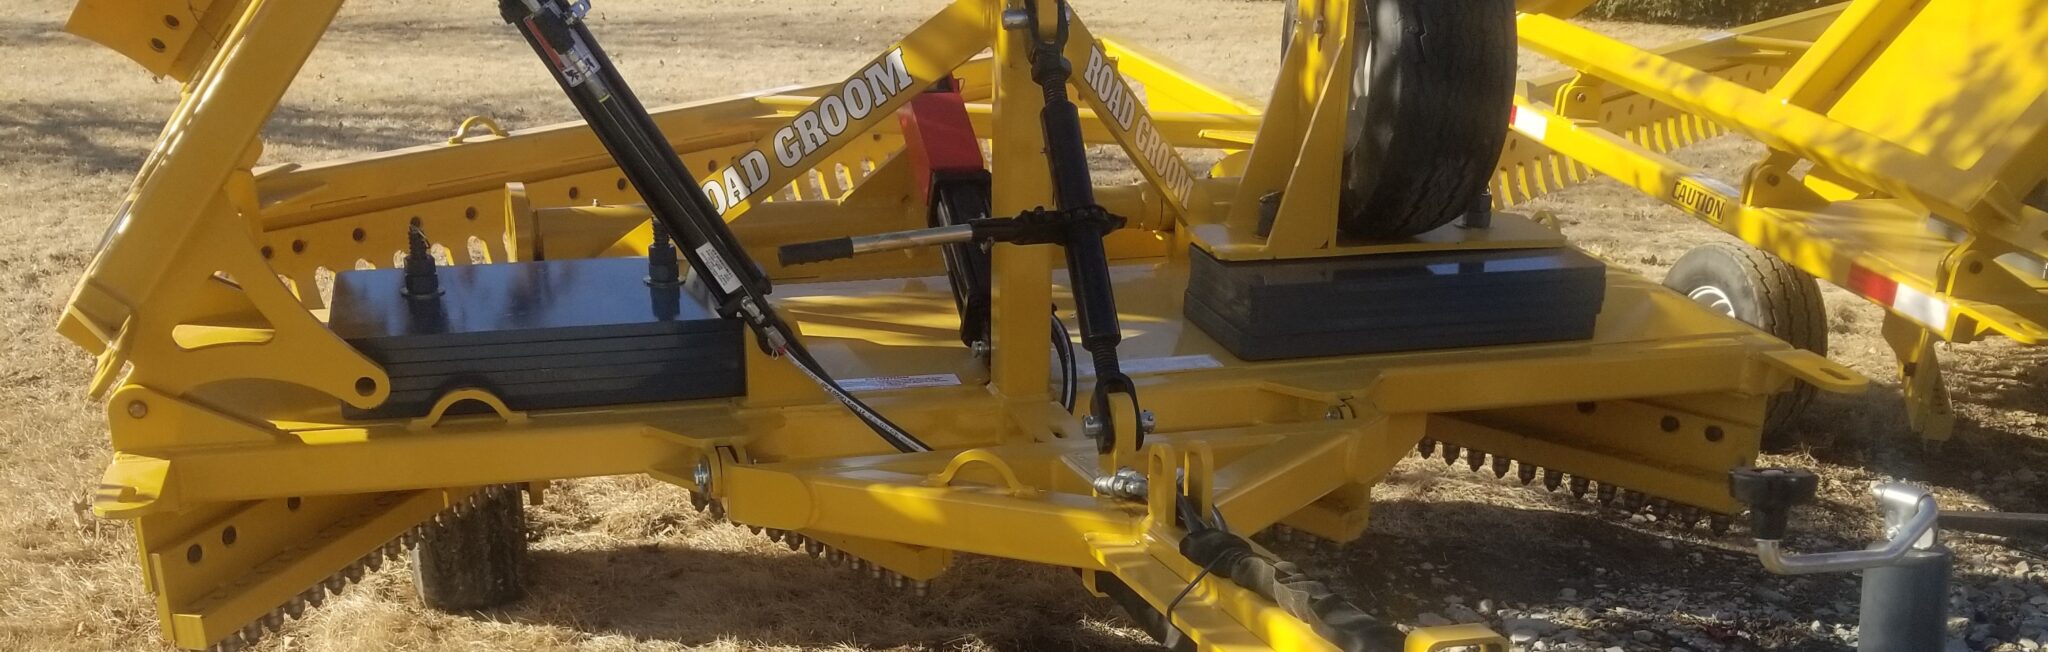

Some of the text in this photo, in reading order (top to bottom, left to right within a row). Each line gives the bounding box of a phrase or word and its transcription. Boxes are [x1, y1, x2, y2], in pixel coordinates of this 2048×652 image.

[701, 45, 913, 217] OAD GROOM
[1083, 44, 1194, 211] ROAD GROOM
[1672, 180, 1725, 220] CAUTION
